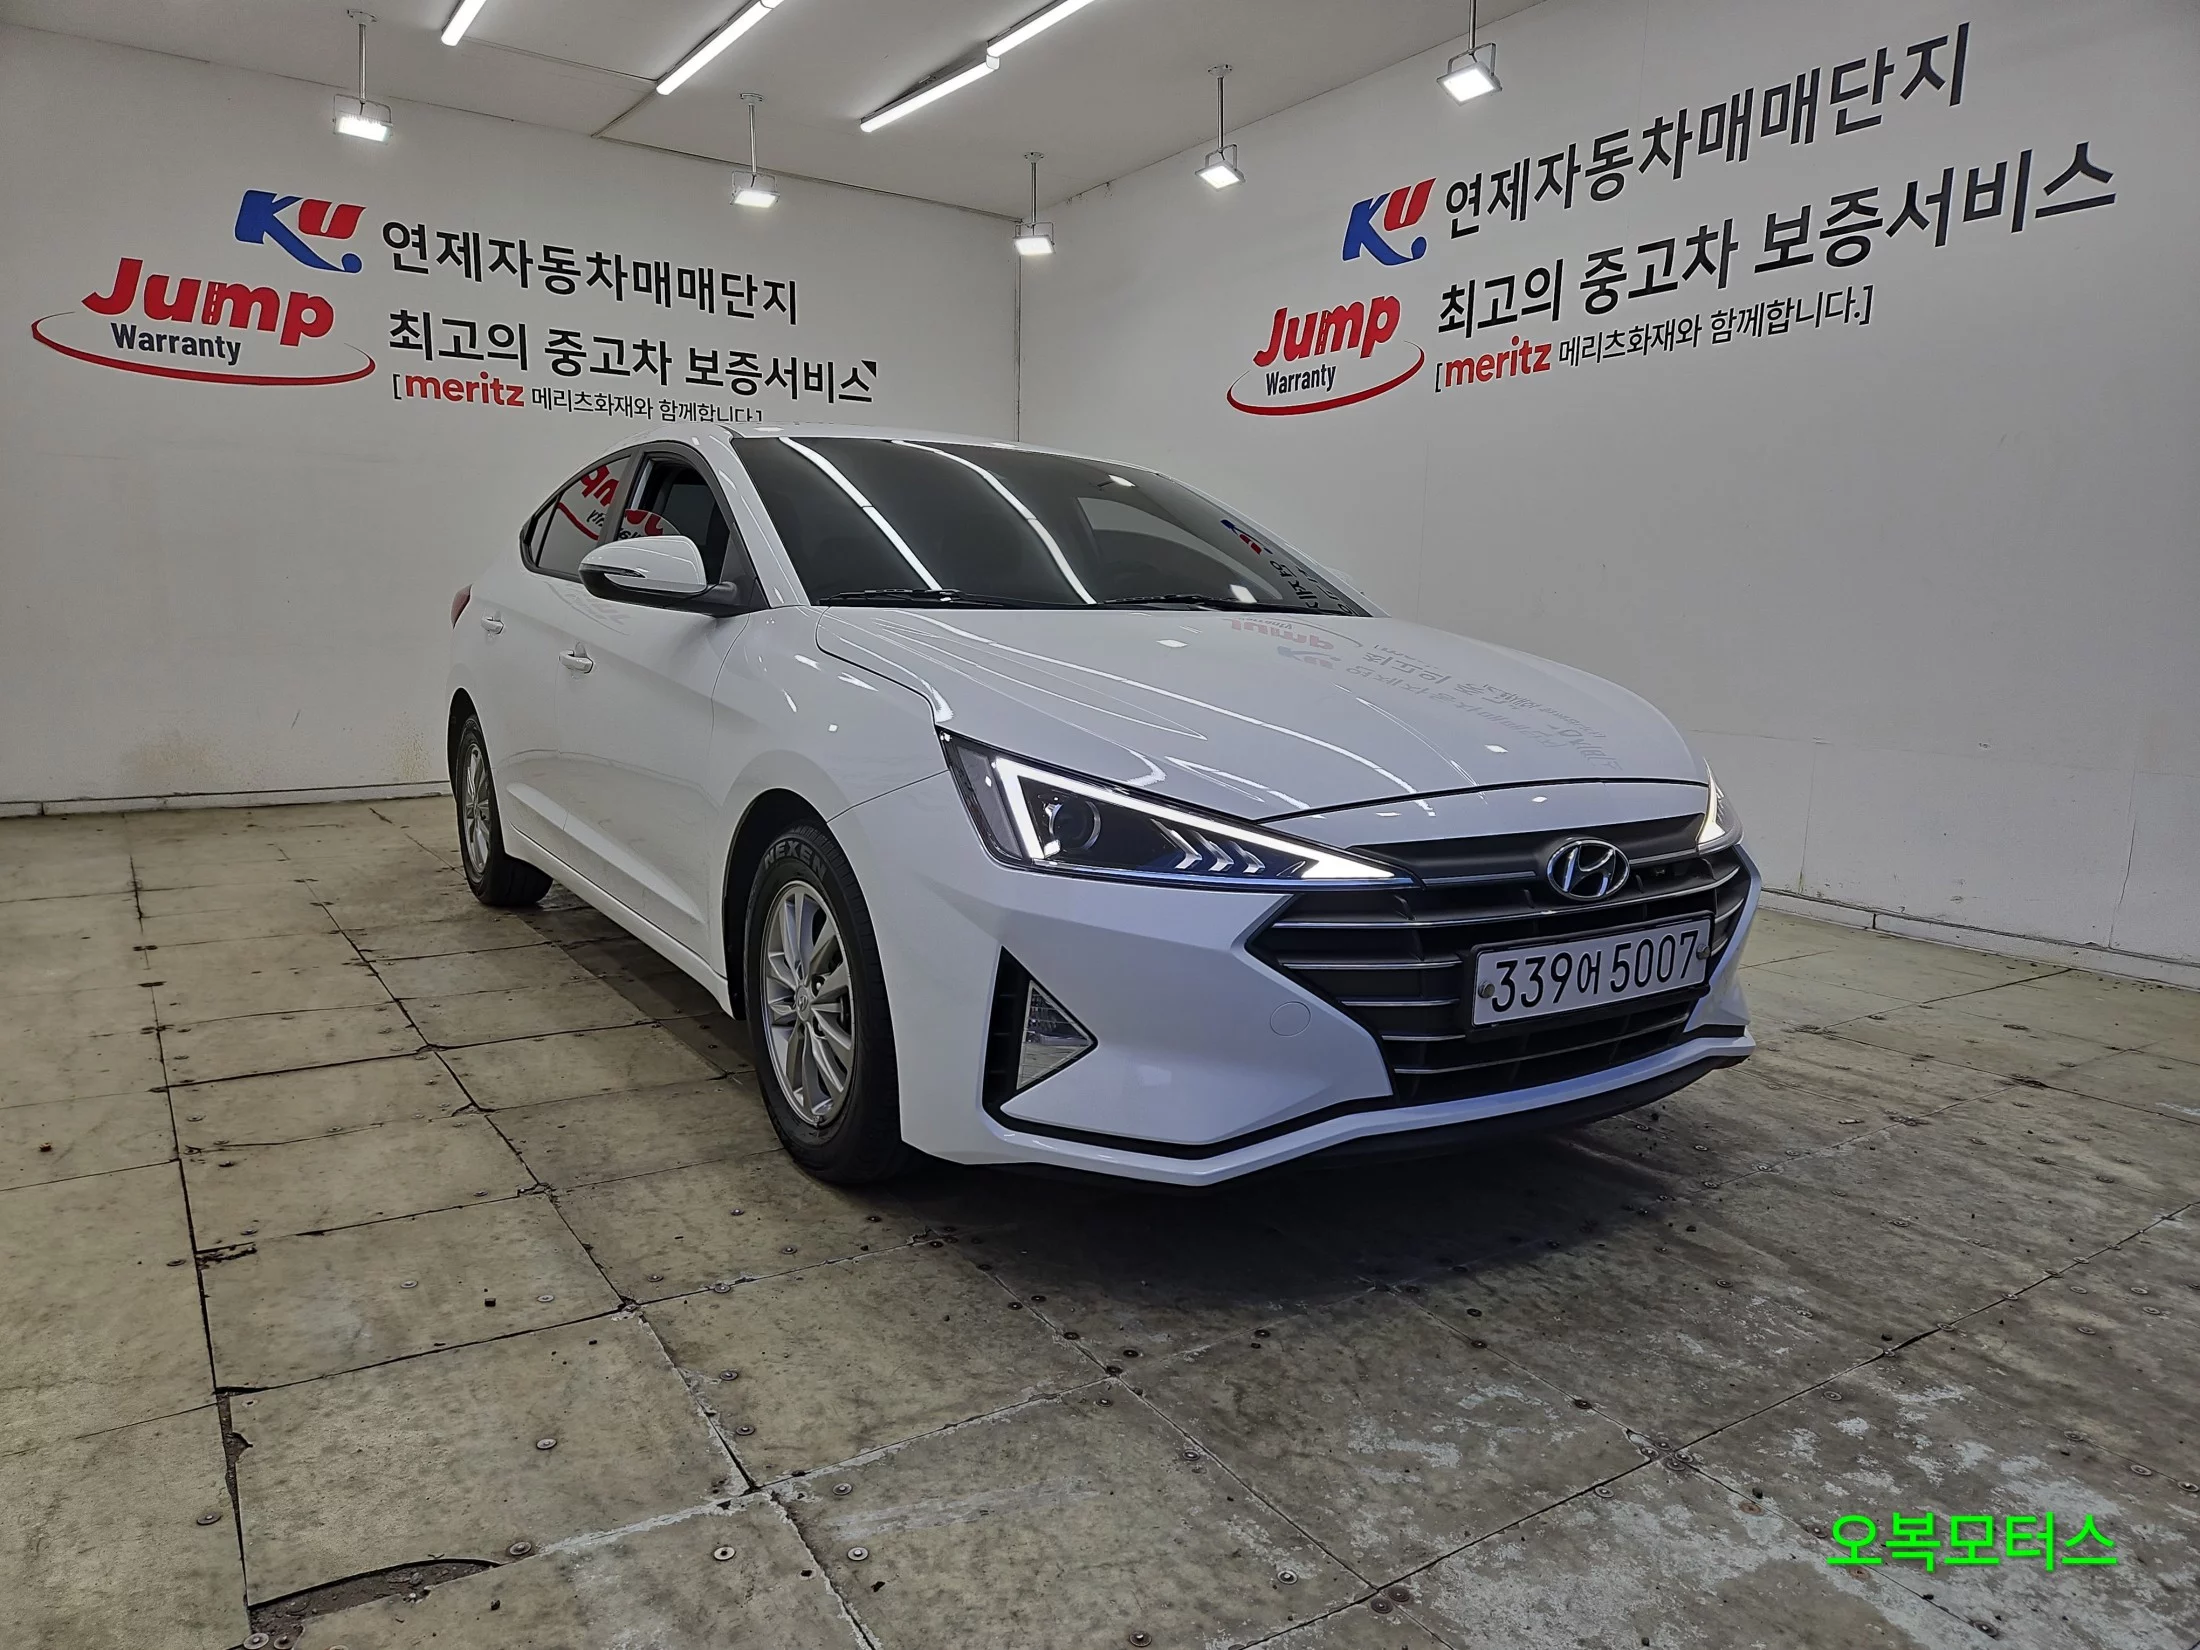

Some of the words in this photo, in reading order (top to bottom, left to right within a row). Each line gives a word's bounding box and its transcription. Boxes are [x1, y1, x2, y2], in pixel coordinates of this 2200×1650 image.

[1444, 21, 1971, 239] 연제자동차매매단지
[382, 221, 797, 326] 연제자동차매매단지
[1438, 258, 1564, 339] 최고의
[1579, 218, 1739, 315] 중고차
[1754, 141, 2117, 274] 보증서비스
[81, 256, 335, 347] Jump
[1252, 295, 1401, 368] Jump
[1558, 313, 1703, 367] 메리츠화재와
[1711, 284, 1874, 345] 함께합니다.]
[111, 322, 242, 366] Warranty
[389, 309, 528, 371] 최고의
[544, 328, 673, 387] 중고차
[685, 347, 873, 404] 보증서비스
[1265, 363, 1337, 397] Warranty
[530, 387, 654, 420] 메리츠화재와
[764, 840, 827, 881] NEXEN
[1609, 929, 1700, 993] 5007
